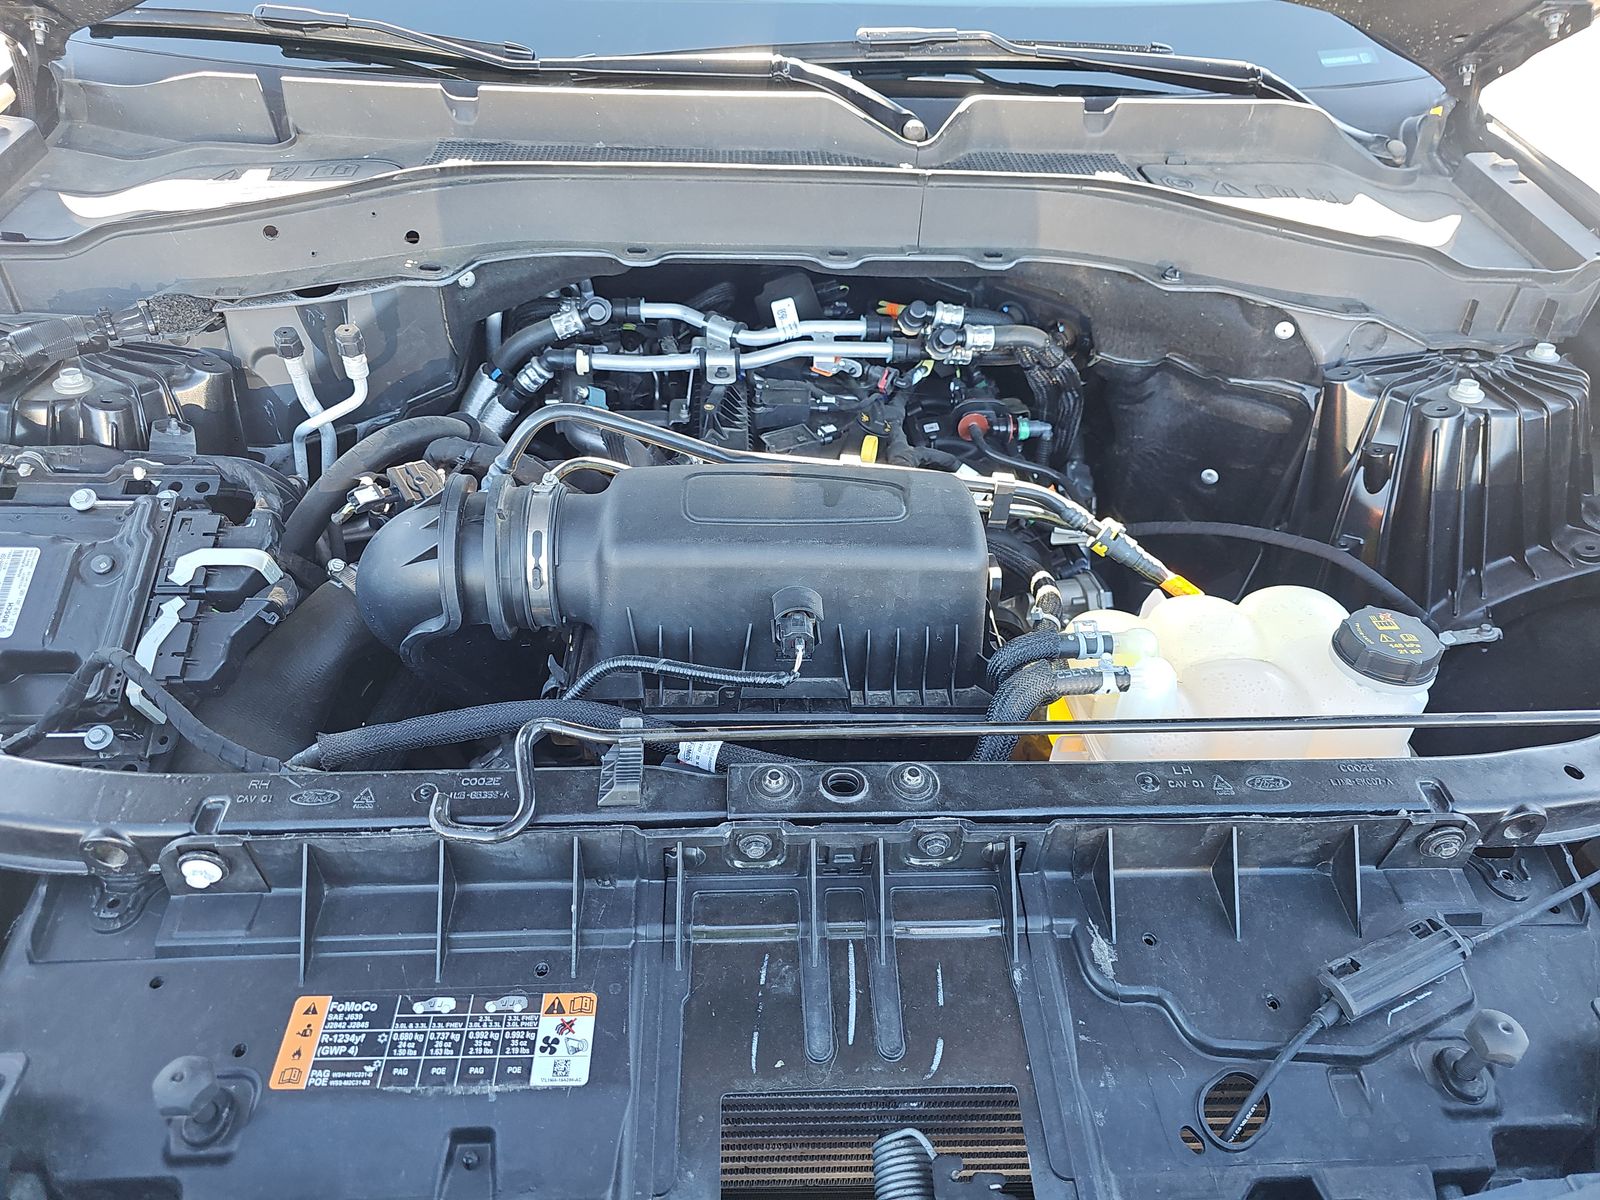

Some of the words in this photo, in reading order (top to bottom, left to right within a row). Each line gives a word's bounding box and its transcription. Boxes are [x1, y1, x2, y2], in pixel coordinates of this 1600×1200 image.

[2, 602, 14, 623] BOSCH
[1172, 765, 1193, 775] LH
[248, 779, 271, 790] RH
[1167, 779, 1187, 788] CAV
[236, 794, 257, 803] CAV
[329, 1001, 378, 1012] FoMoCo
[327, 1013, 344, 1021] SAE
[344, 1013, 364, 1021] J639
[321, 1033, 366, 1045] R-1234yf
[392, 1032, 413, 1041] 0.680
[414, 1032, 425, 1043] kg
[429, 1032, 450, 1041] 0.737
[450, 1032, 461, 1042] kg
[468, 1031, 489, 1040] 0.992
[489, 1031, 500, 1041] kg
[504, 1031, 525, 1039] 0.992
[525, 1031, 536, 1040] kg
[397, 1041, 407, 1049] 24
[316, 1045, 347, 1057] (GWP
[347, 1045, 359, 1057] 4)
[407, 1048, 417, 1056] lbs
[429, 1048, 443, 1056] 1.63
[468, 1047, 483, 1055] 2.19
[483, 1047, 494, 1055] lbs
[505, 1047, 520, 1055] 2.19
[310, 1069, 331, 1078] PAG
[392, 1067, 409, 1076] PAG
[431, 1067, 447, 1075] POE
[468, 1066, 484, 1074] PAG
[507, 1066, 522, 1074] POE
[308, 1077, 329, 1087] POE
